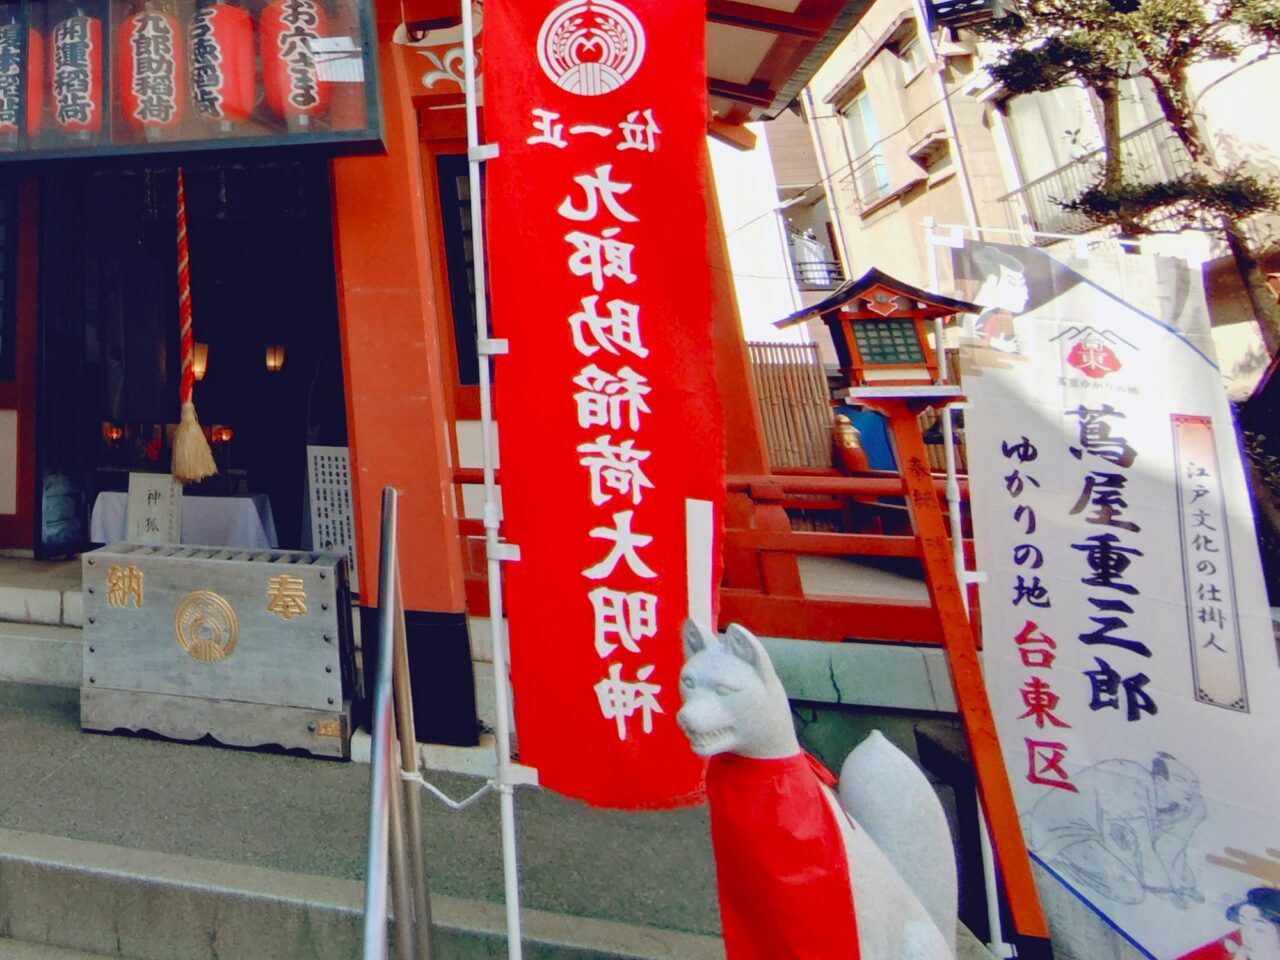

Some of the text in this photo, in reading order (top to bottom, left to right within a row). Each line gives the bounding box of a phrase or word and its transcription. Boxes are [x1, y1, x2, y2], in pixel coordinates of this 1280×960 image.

[130, 12, 177, 123] 九郎助稲荷
[1064, 403, 1158, 722] 蔦屋重三郎
[1186, 461, 1228, 654] 江戸文化の仕掛人
